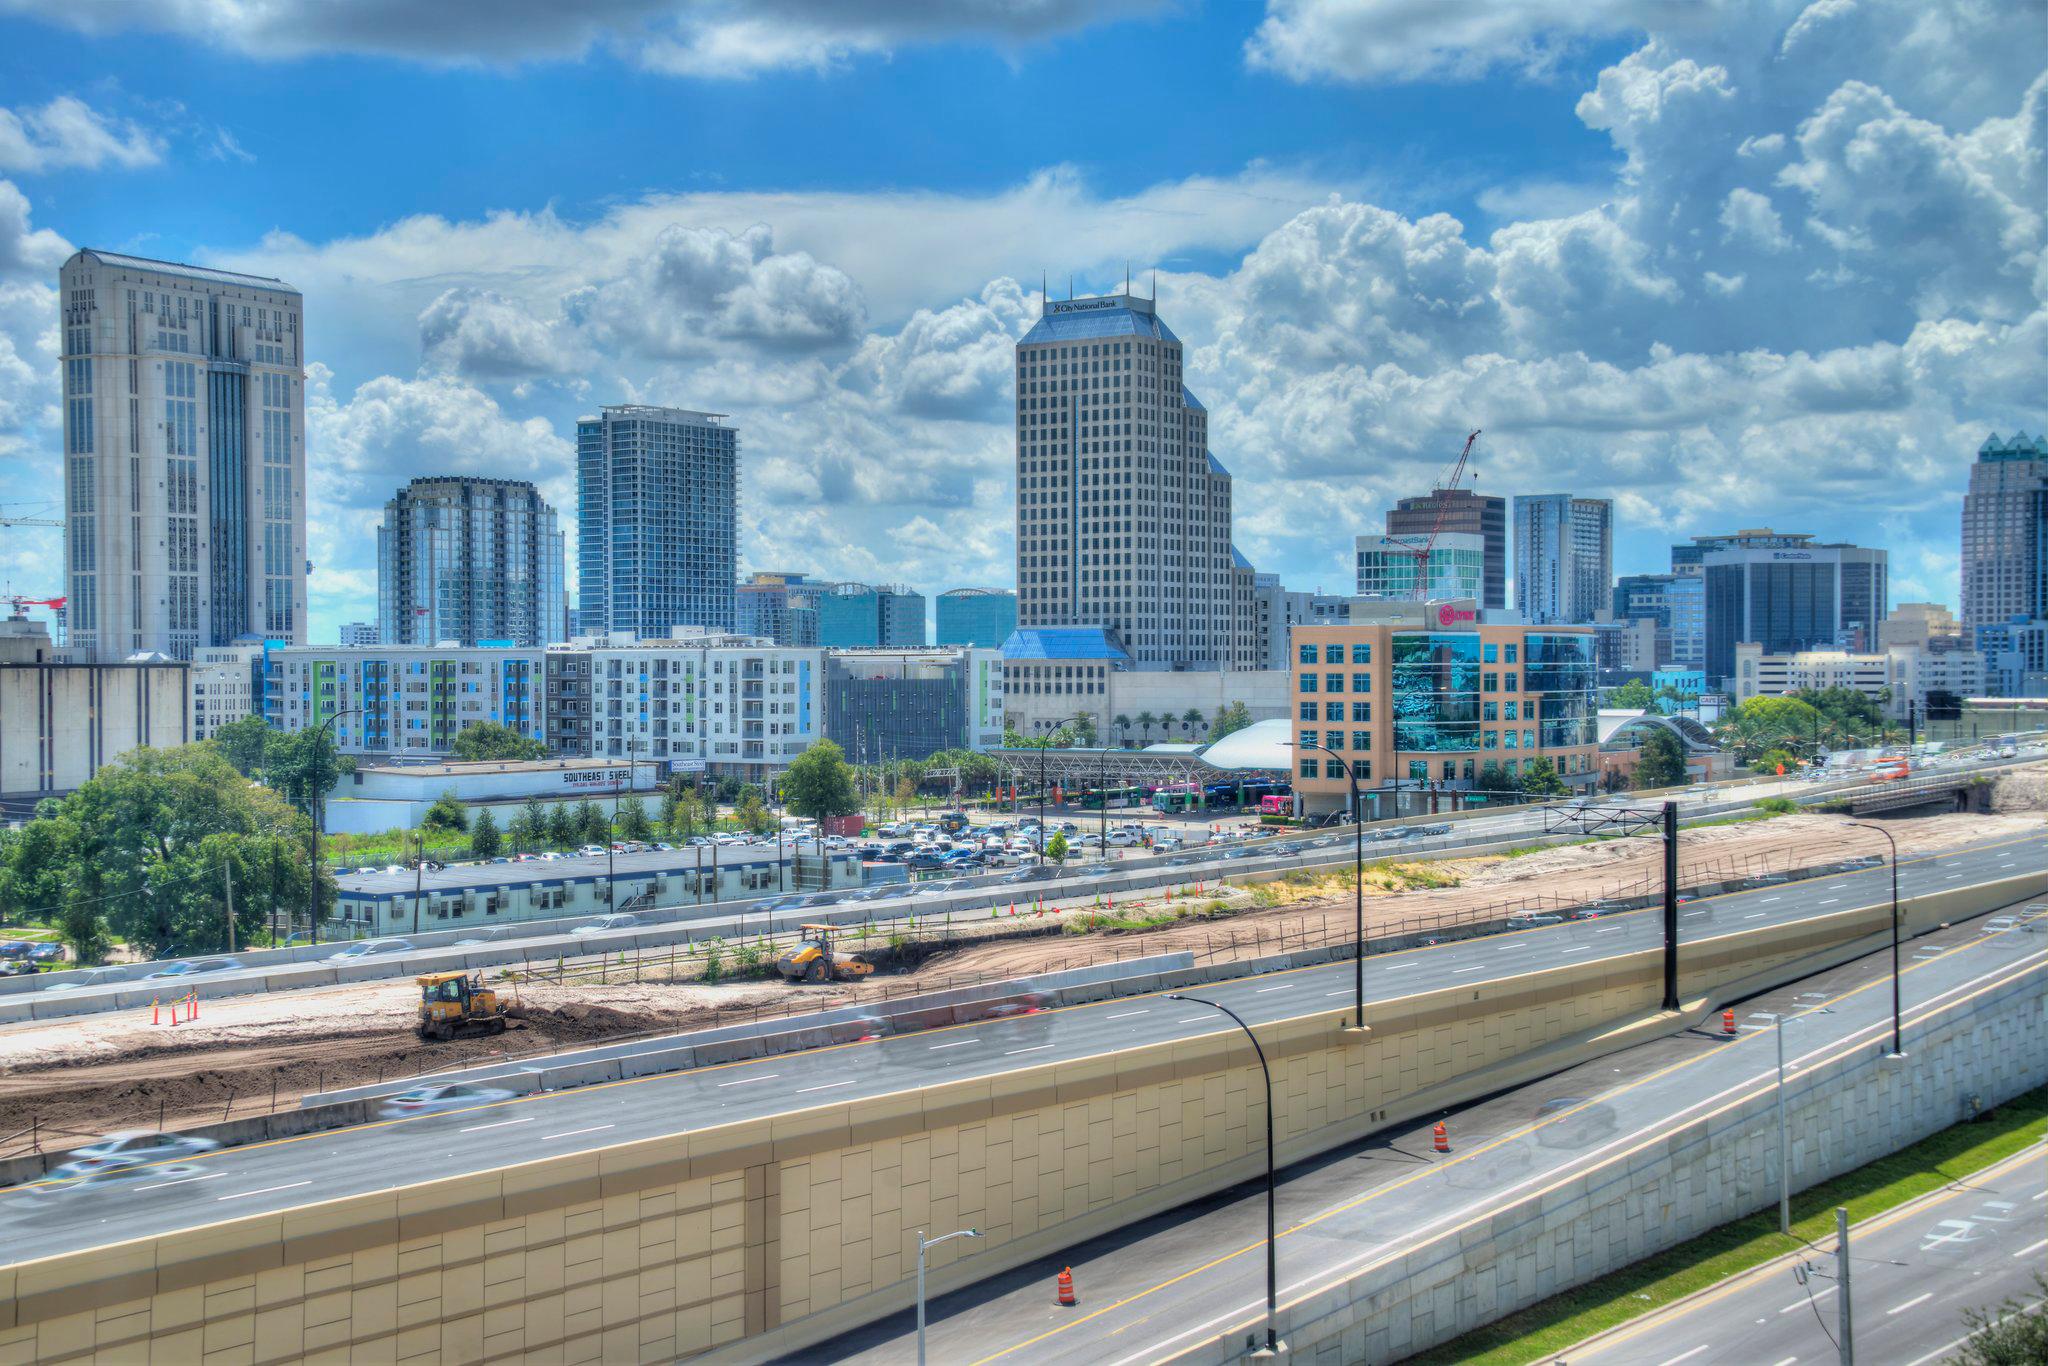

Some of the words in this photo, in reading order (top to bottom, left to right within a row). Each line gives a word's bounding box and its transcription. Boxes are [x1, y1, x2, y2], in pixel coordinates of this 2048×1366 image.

[1060, 304, 1073, 312] City
[1073, 302, 1100, 311] National
[1100, 300, 1117, 309] Bank
[563, 771, 606, 783] SOUTHEAST
[609, 770, 632, 780] STEEL
